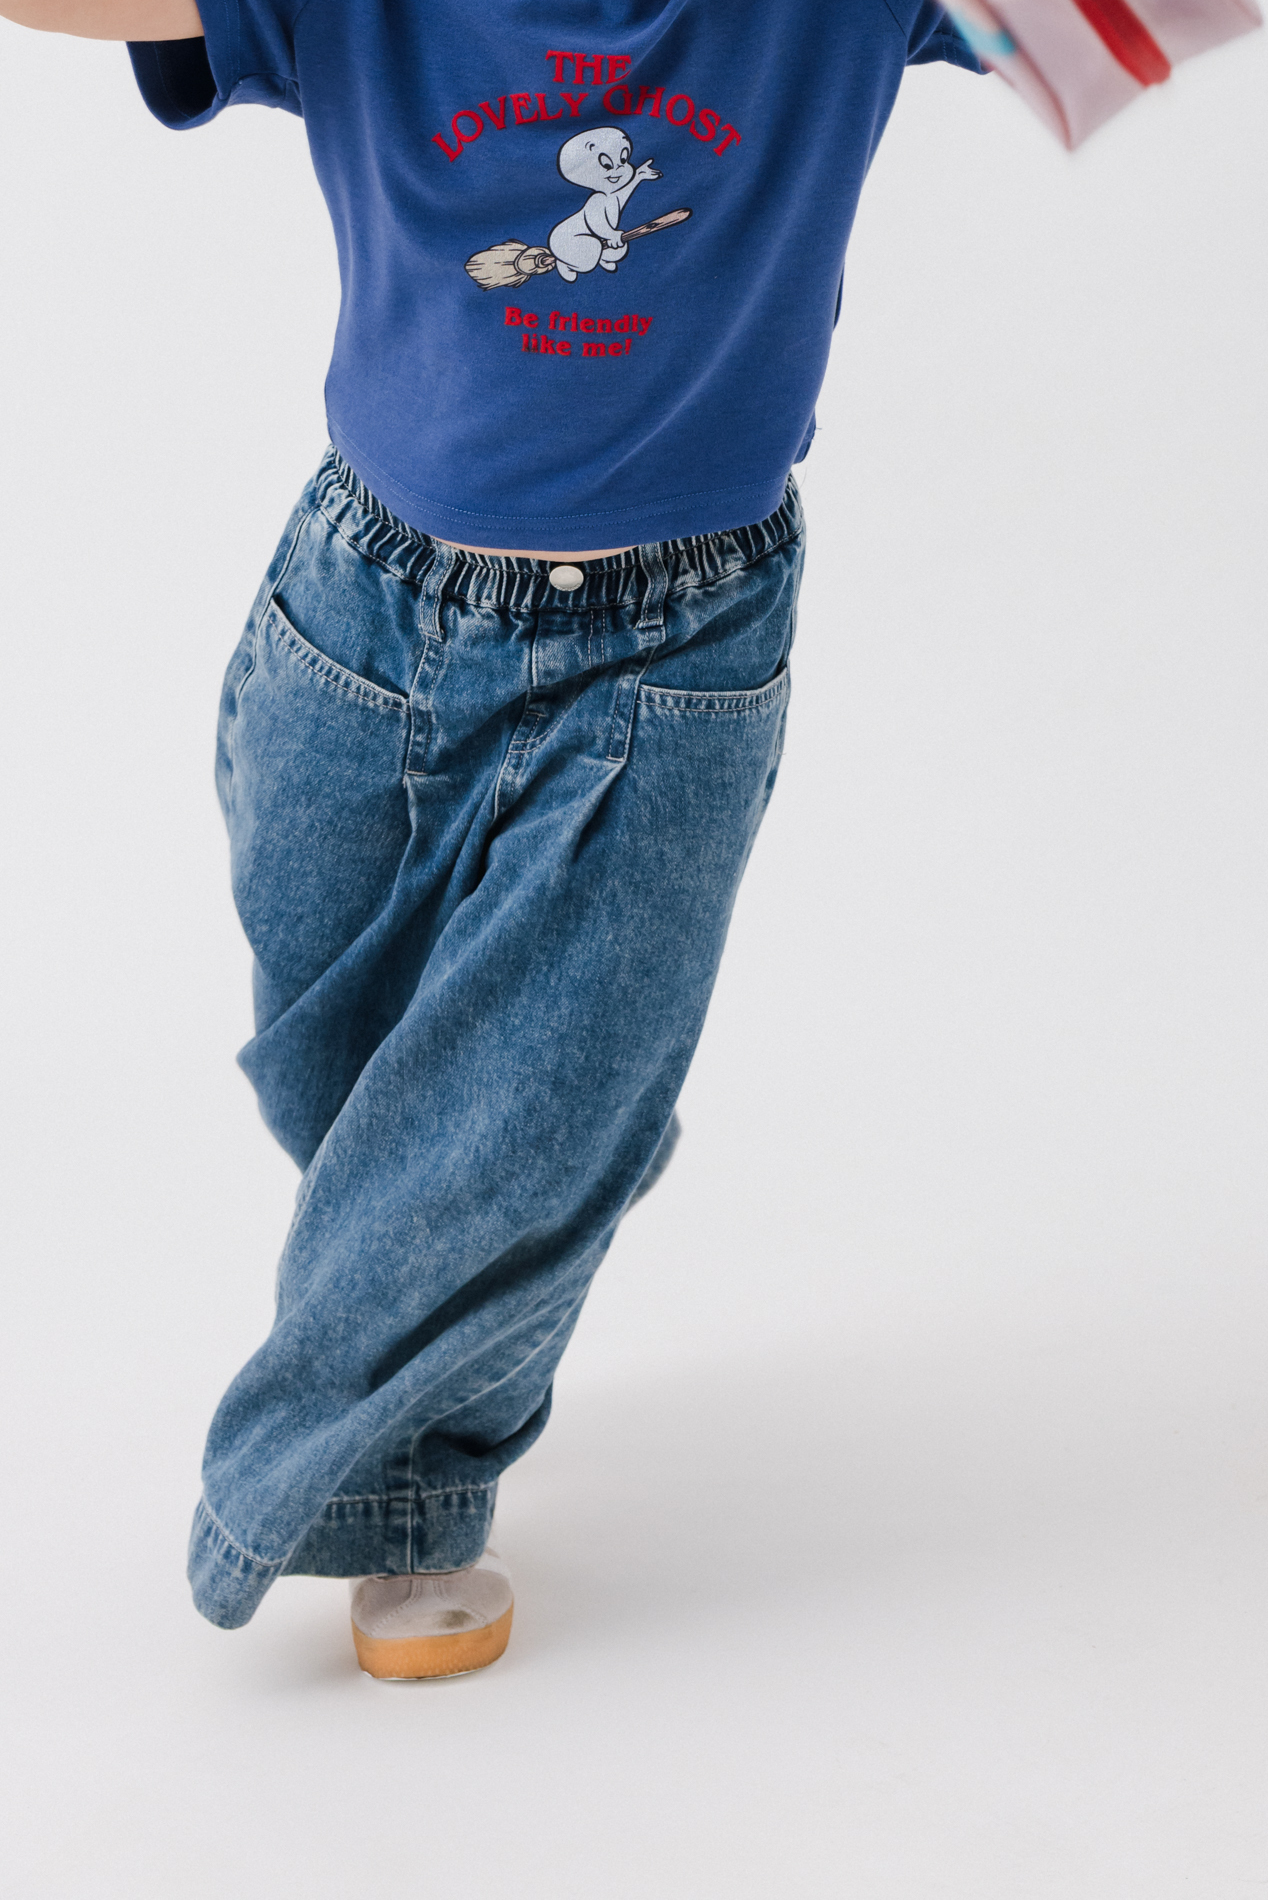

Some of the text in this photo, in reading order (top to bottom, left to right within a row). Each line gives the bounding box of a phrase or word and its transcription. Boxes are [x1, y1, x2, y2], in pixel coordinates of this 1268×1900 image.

[545, 50, 632, 85] THE
[431, 84, 742, 163] LOVELY GHOST
[504, 306, 653, 336] Be friendly
[521, 333, 633, 358] like me!
